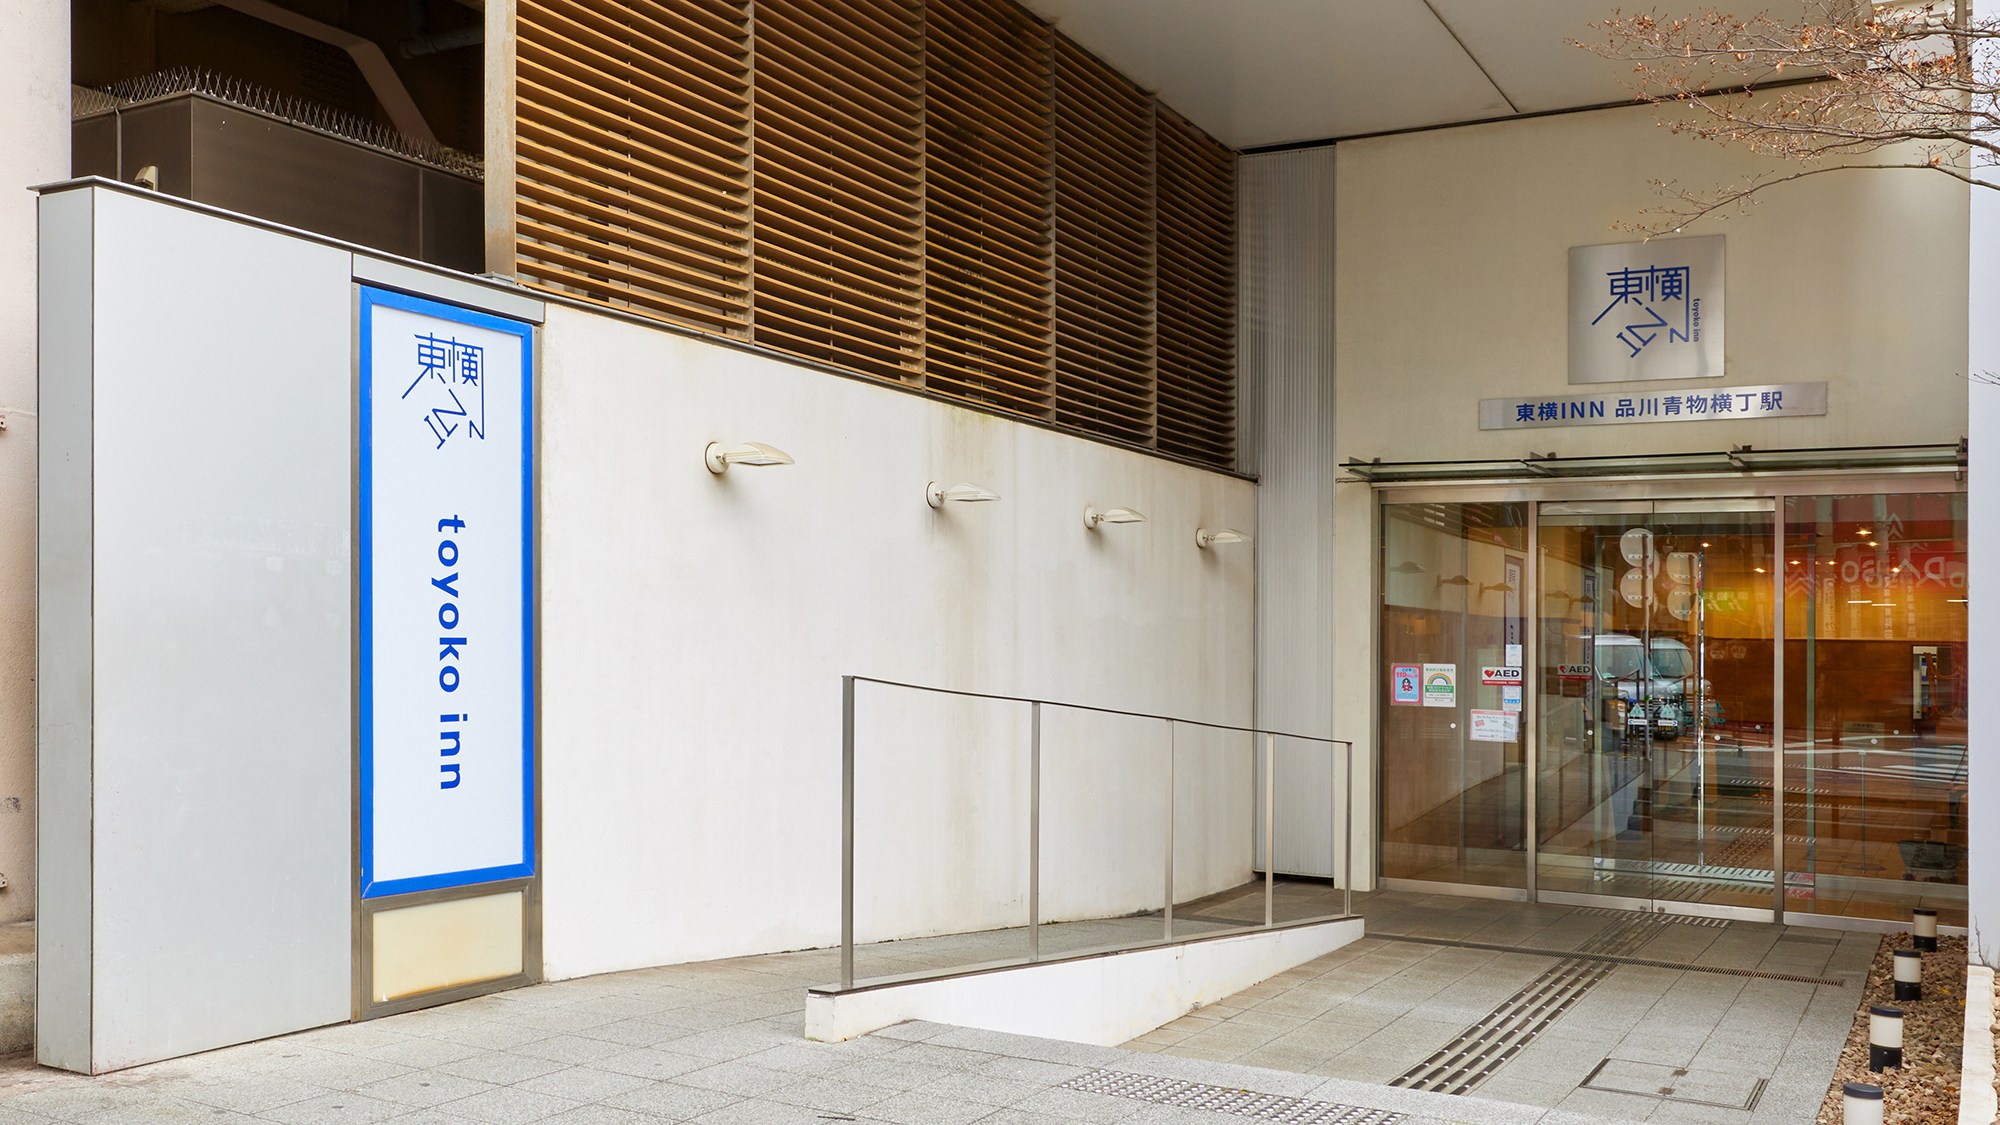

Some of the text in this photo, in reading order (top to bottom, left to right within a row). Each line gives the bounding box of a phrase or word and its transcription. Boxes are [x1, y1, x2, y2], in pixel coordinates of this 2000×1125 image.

[1692, 298, 1701, 342] toyoko inn
[1515, 391, 1783, 422] 東横INN 品川青物横丁駅
[431, 514, 469, 789] toyoko inn
[1495, 669, 1520, 678] AED
[1569, 665, 1591, 673] AED
